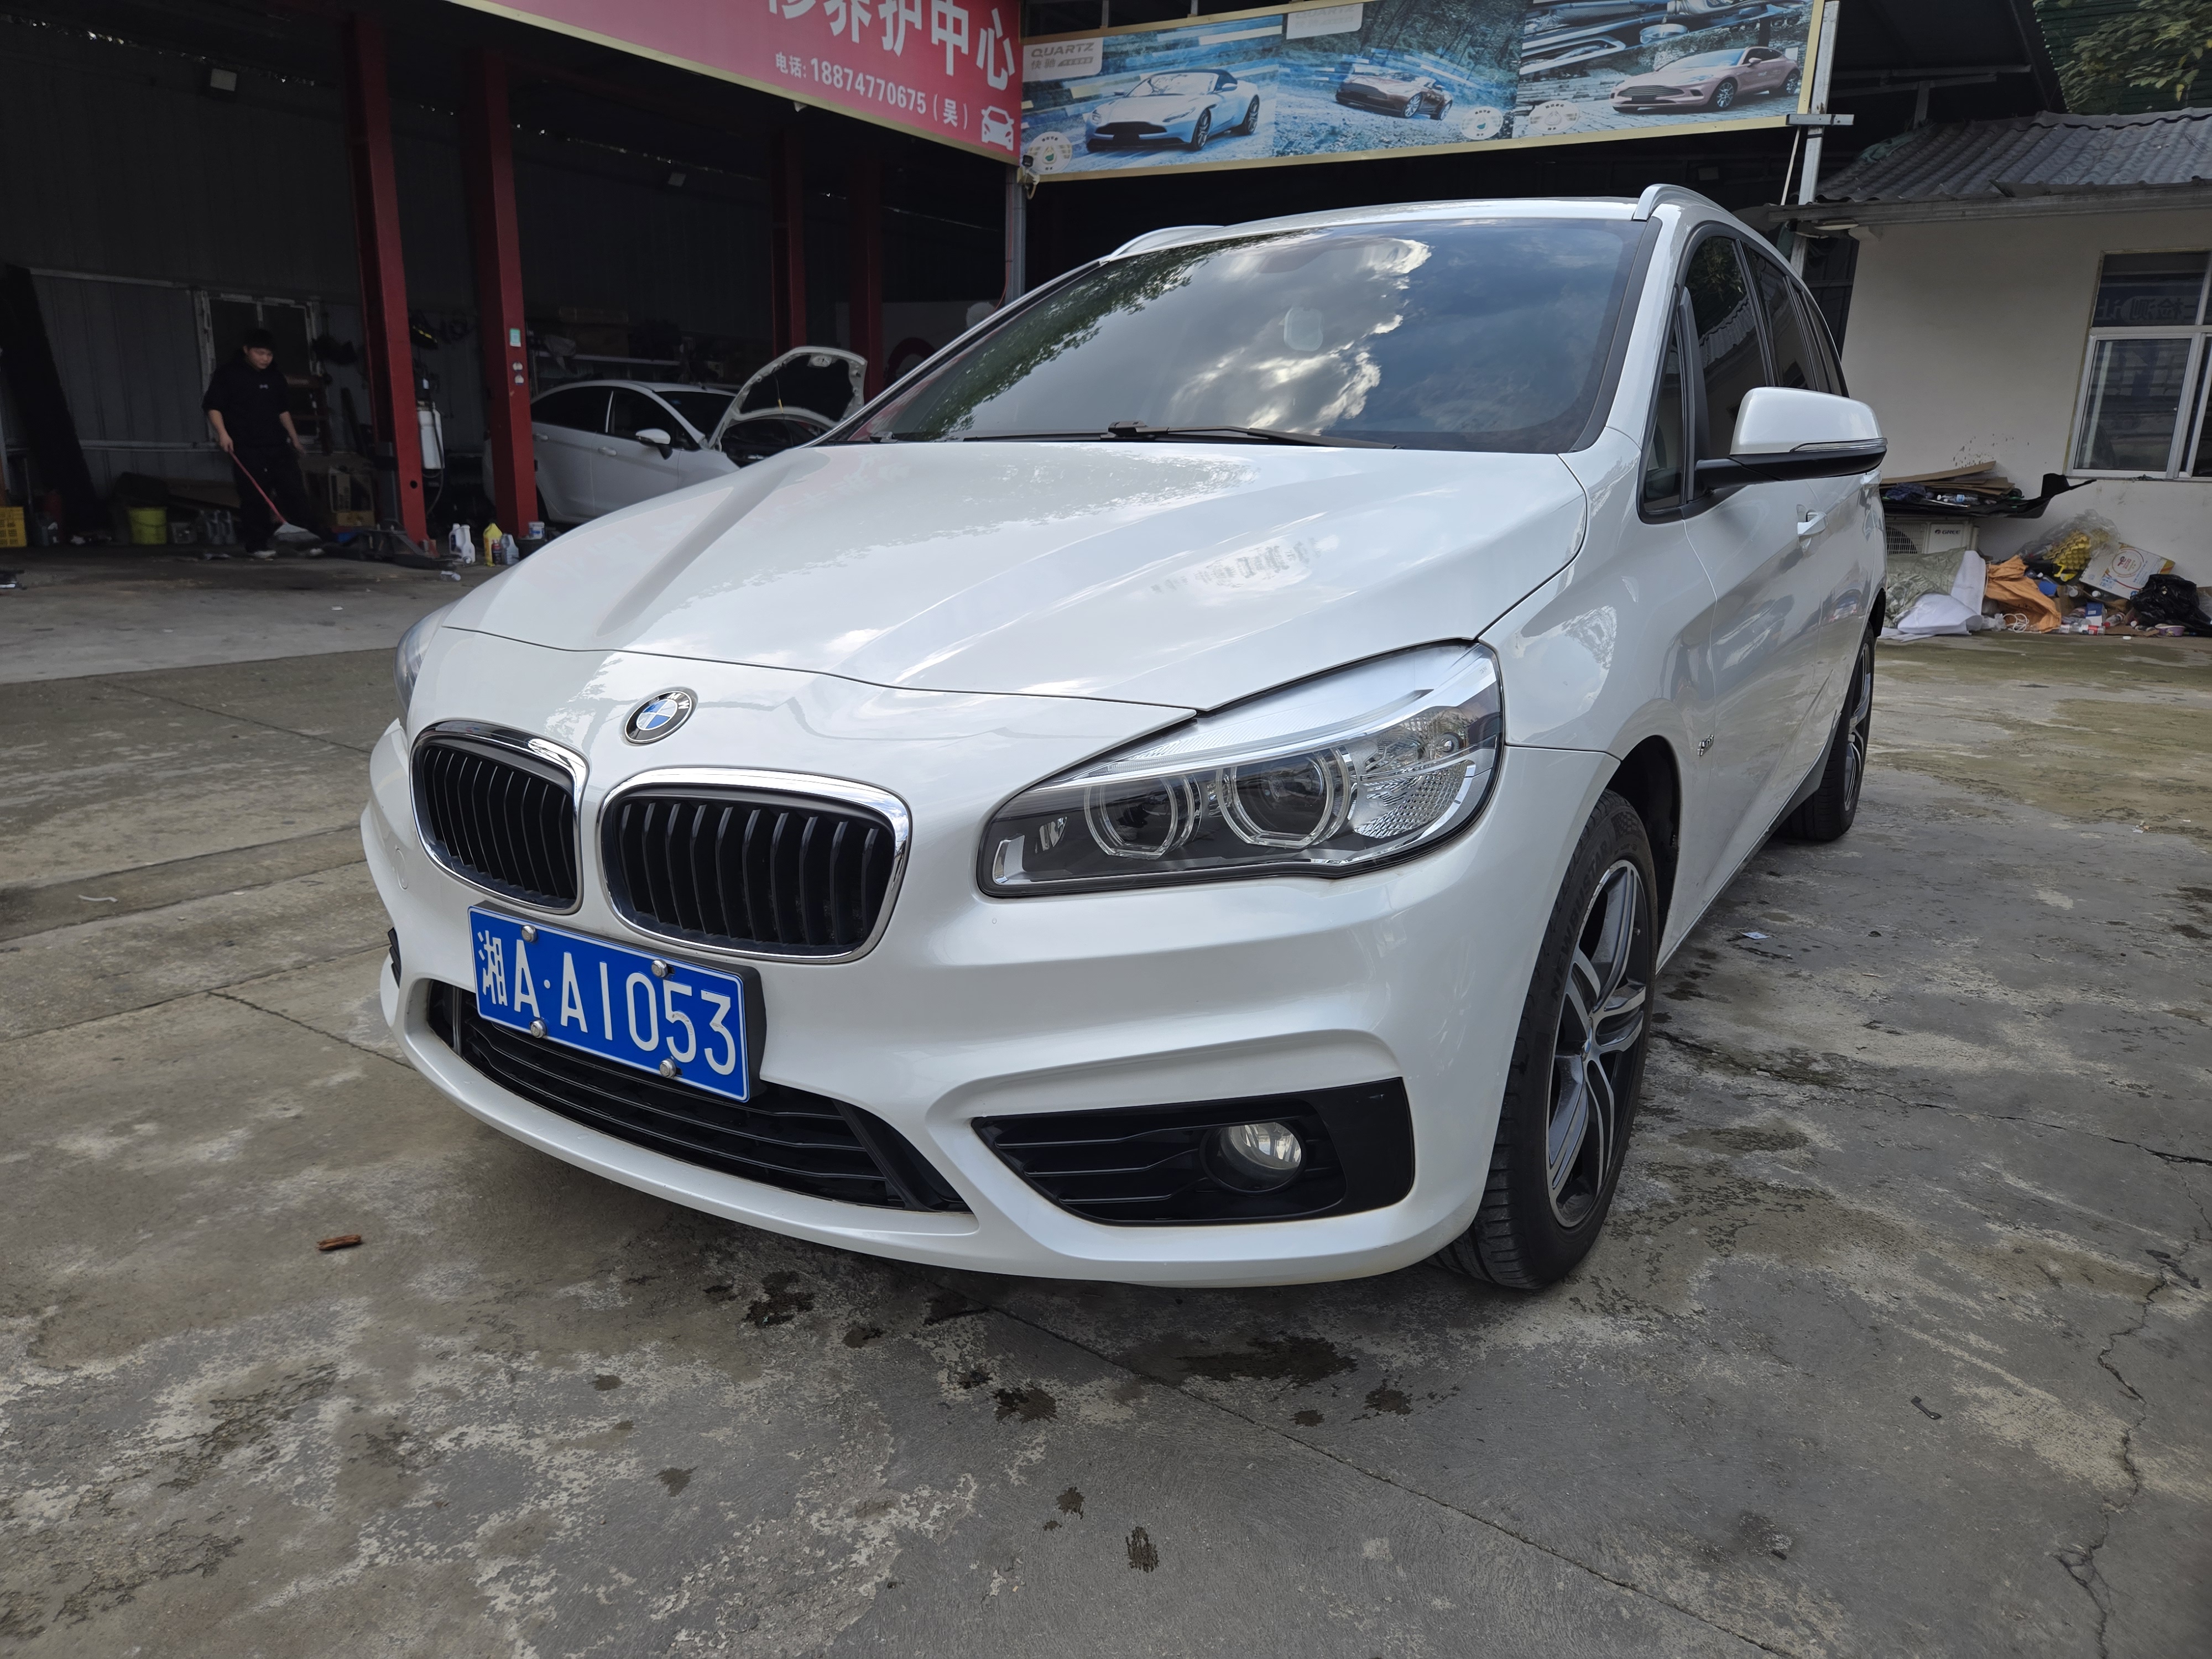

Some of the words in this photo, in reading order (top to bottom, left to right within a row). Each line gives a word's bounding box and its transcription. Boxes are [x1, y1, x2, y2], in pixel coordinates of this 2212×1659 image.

[769, 0, 1015, 90] 养护中心
[1031, 42, 1094, 58] QUARTZ
